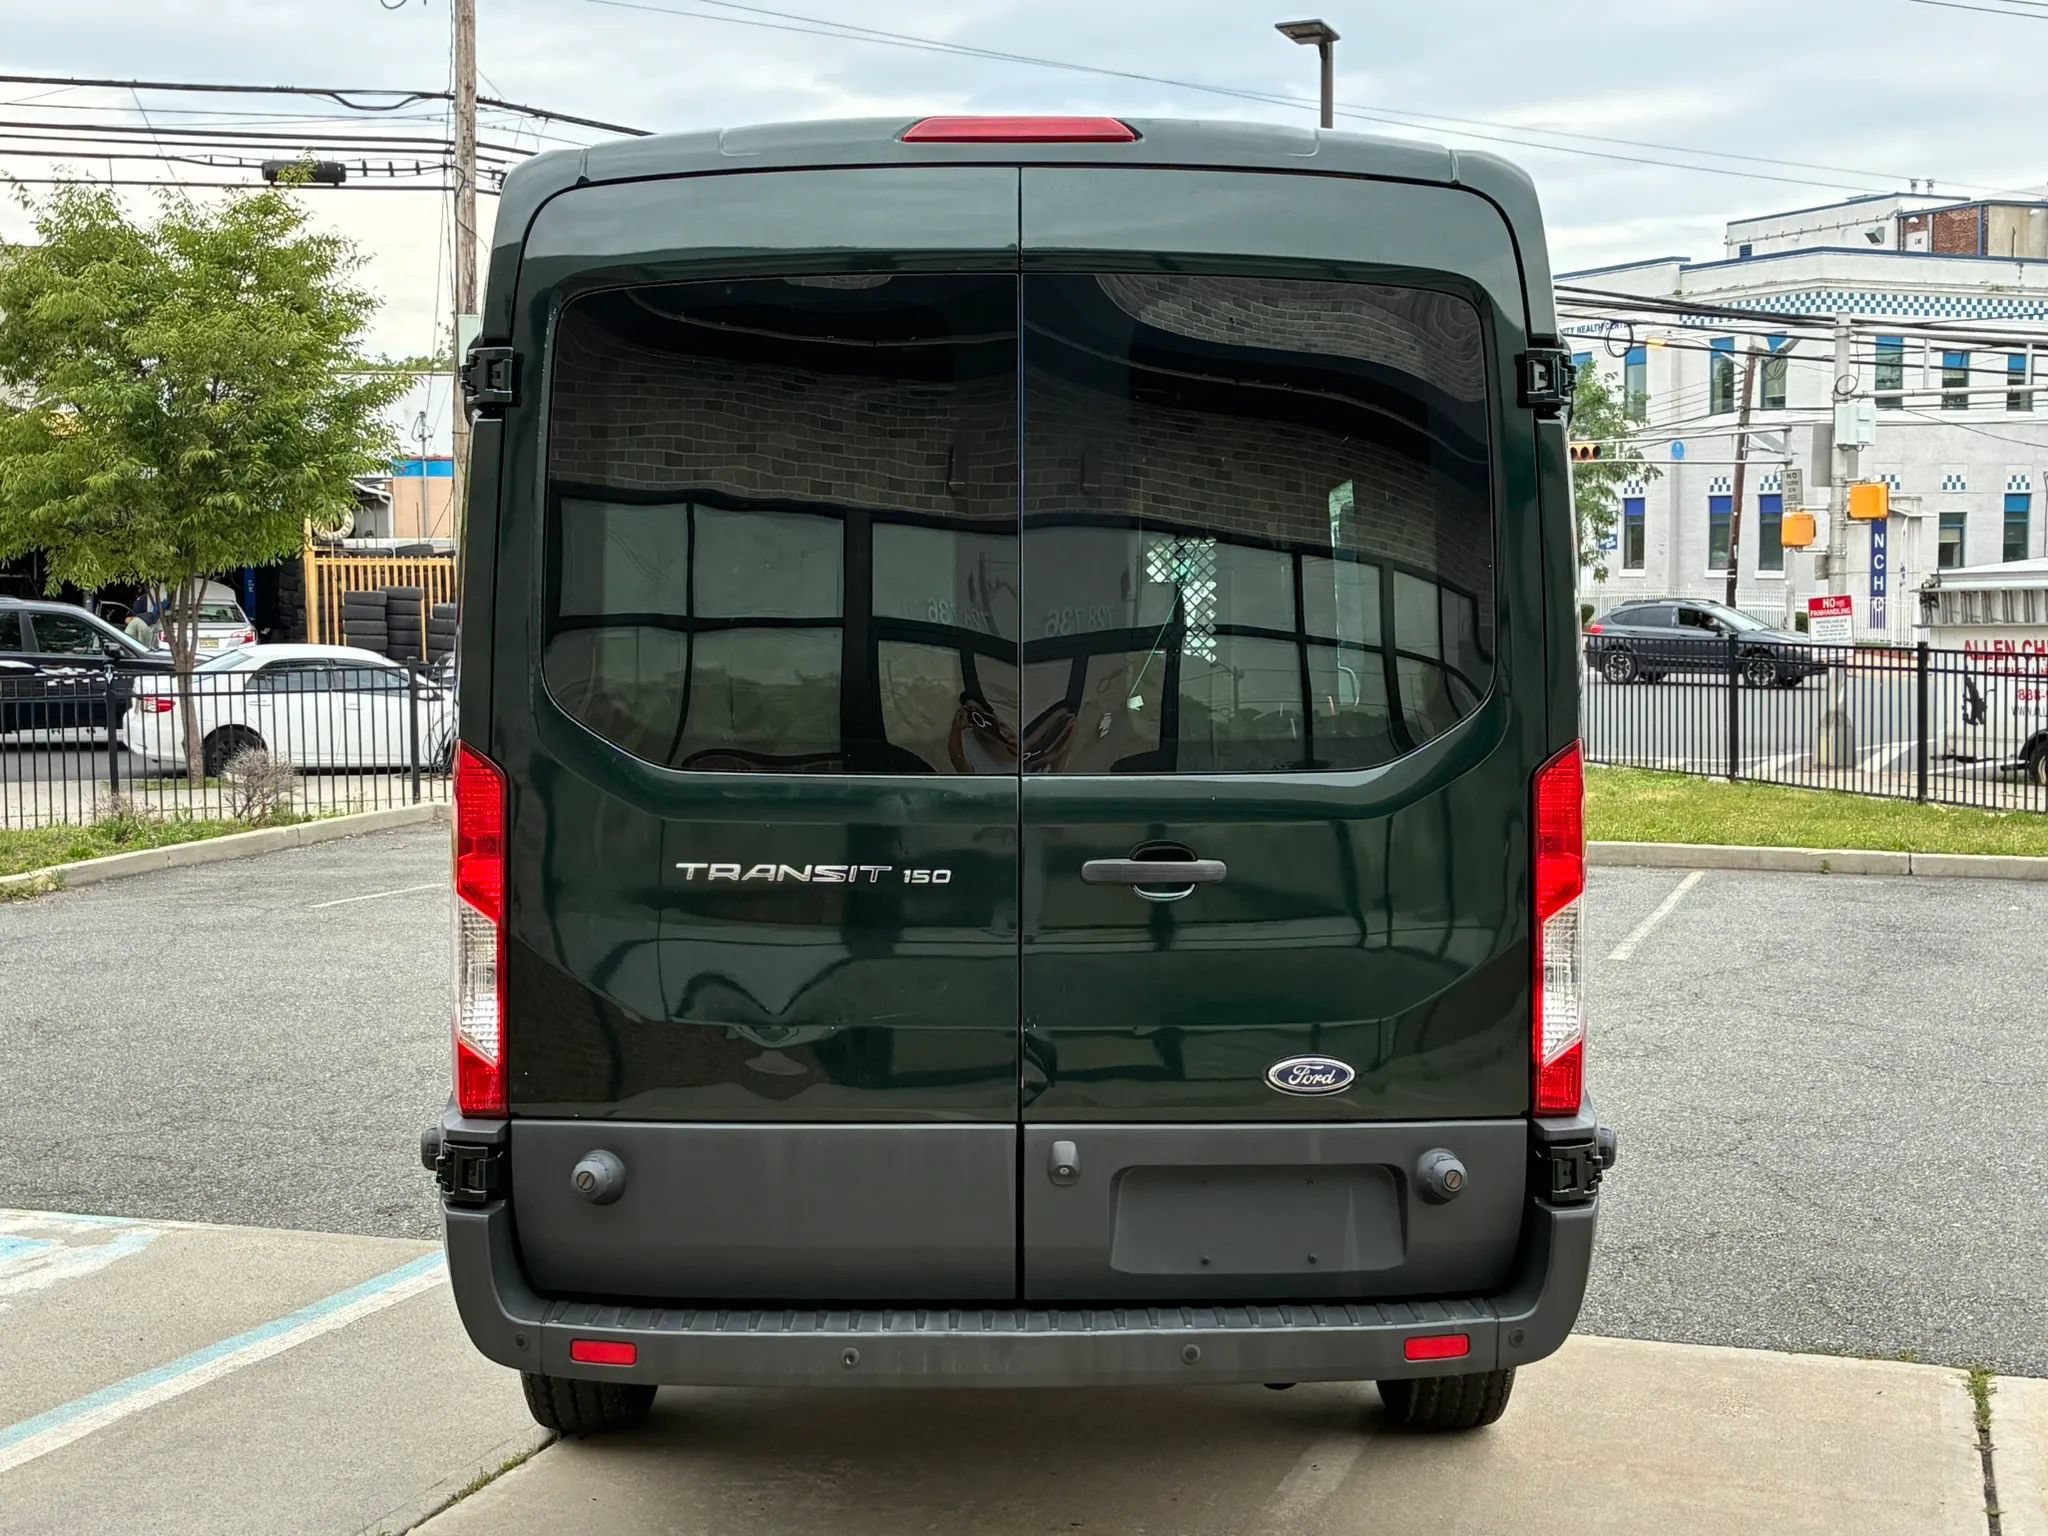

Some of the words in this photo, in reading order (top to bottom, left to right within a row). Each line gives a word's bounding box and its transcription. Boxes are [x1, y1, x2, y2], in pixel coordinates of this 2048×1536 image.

[1576, 322, 1604, 334] HEALTH
[1786, 472, 1798, 480] NO
[1822, 598, 1836, 609] NO
[1964, 639, 2016, 661] ALLEN
[676, 862, 893, 883] TRANSIT
[903, 869, 952, 884] 150
[1288, 1064, 1336, 1085] Ford
